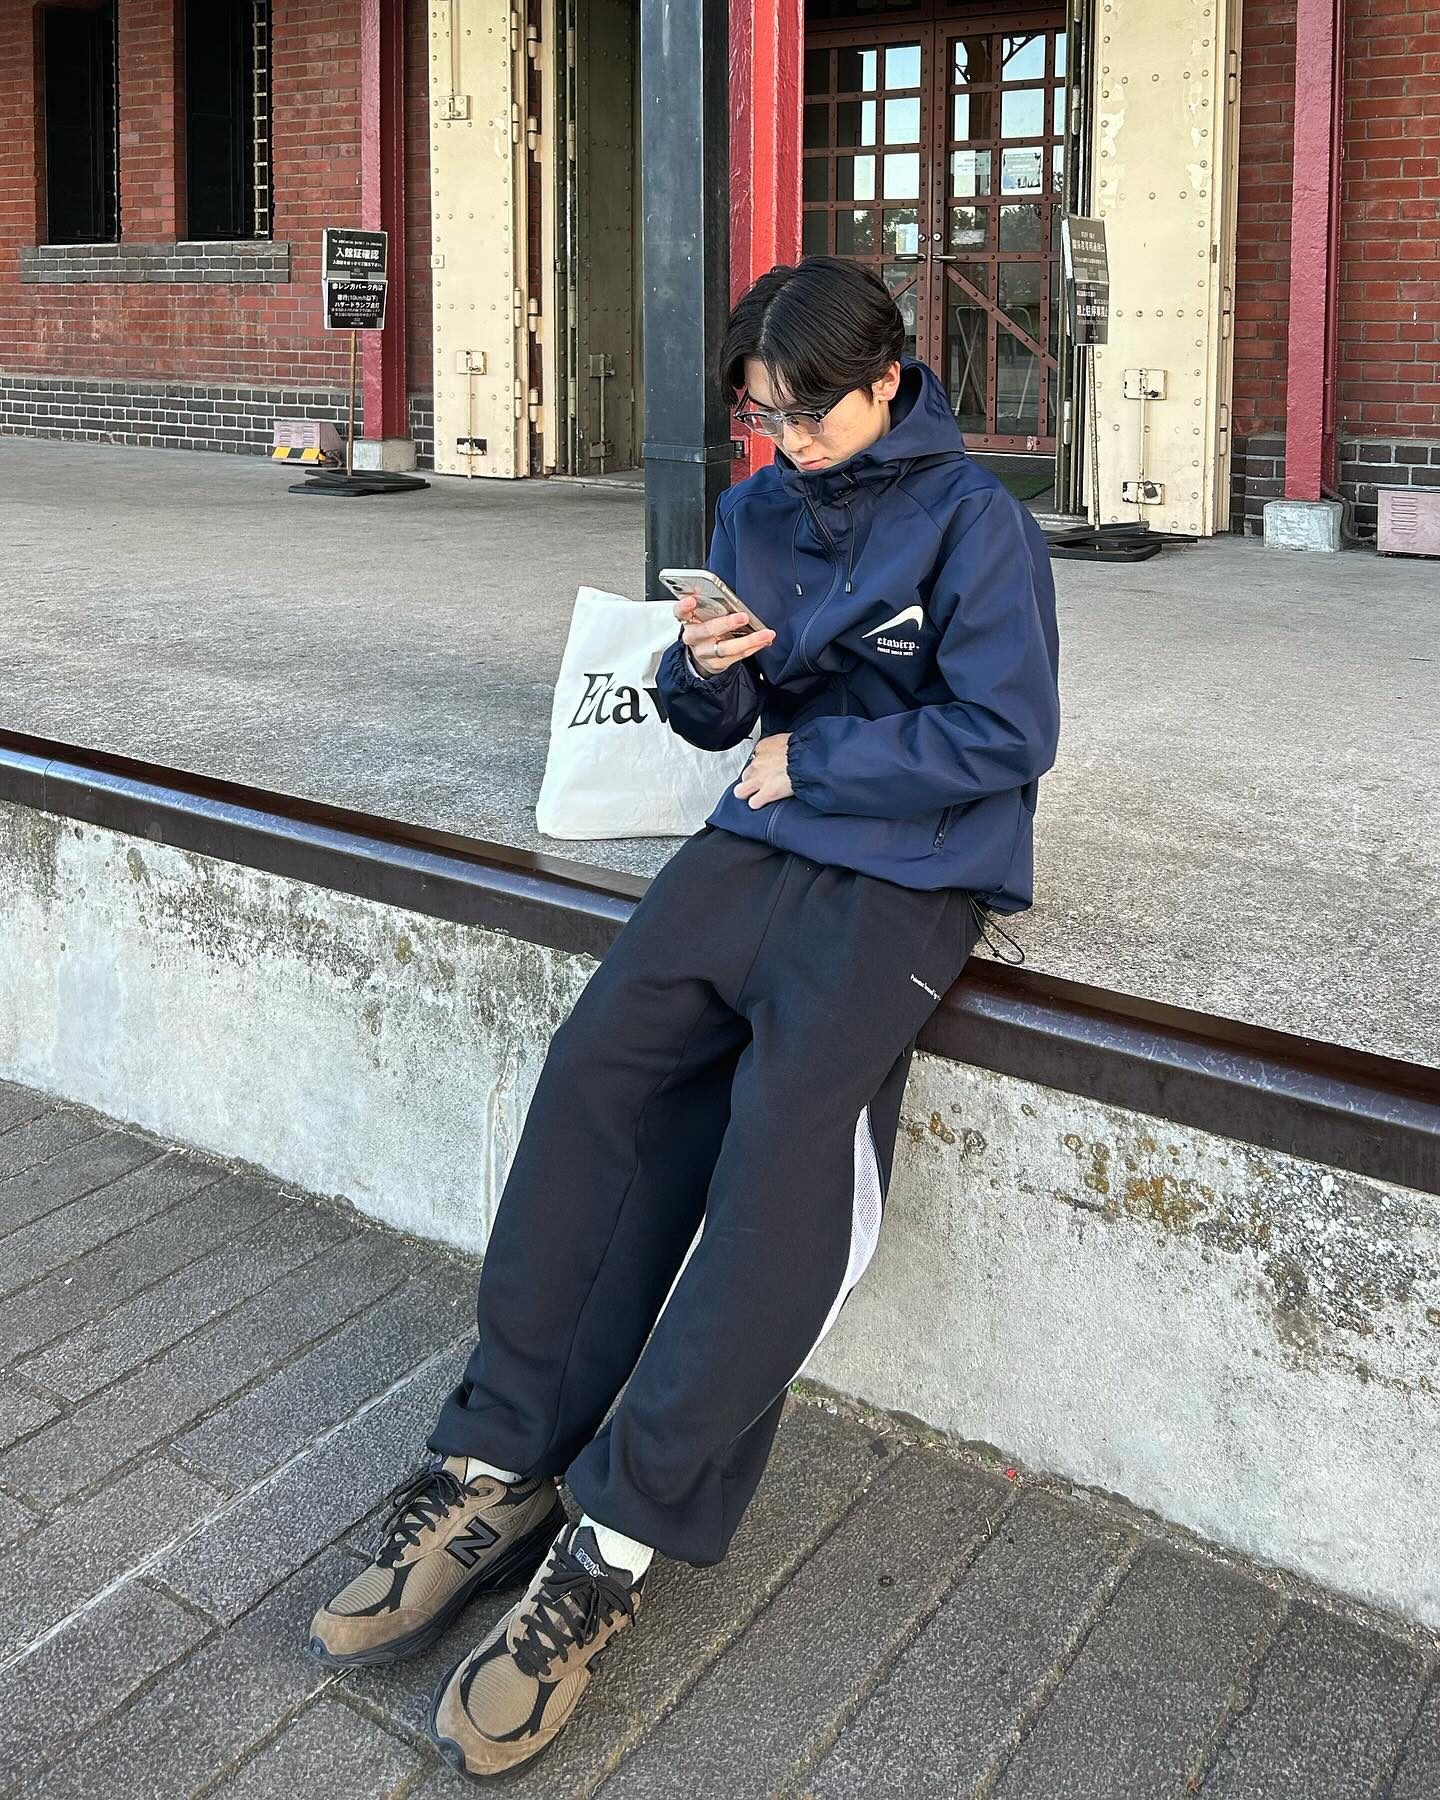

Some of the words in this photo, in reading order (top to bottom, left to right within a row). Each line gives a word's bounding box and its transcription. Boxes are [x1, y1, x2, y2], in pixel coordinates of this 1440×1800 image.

[335, 247, 380, 260] 入館証確認
[444, 1515, 501, 1570] N
